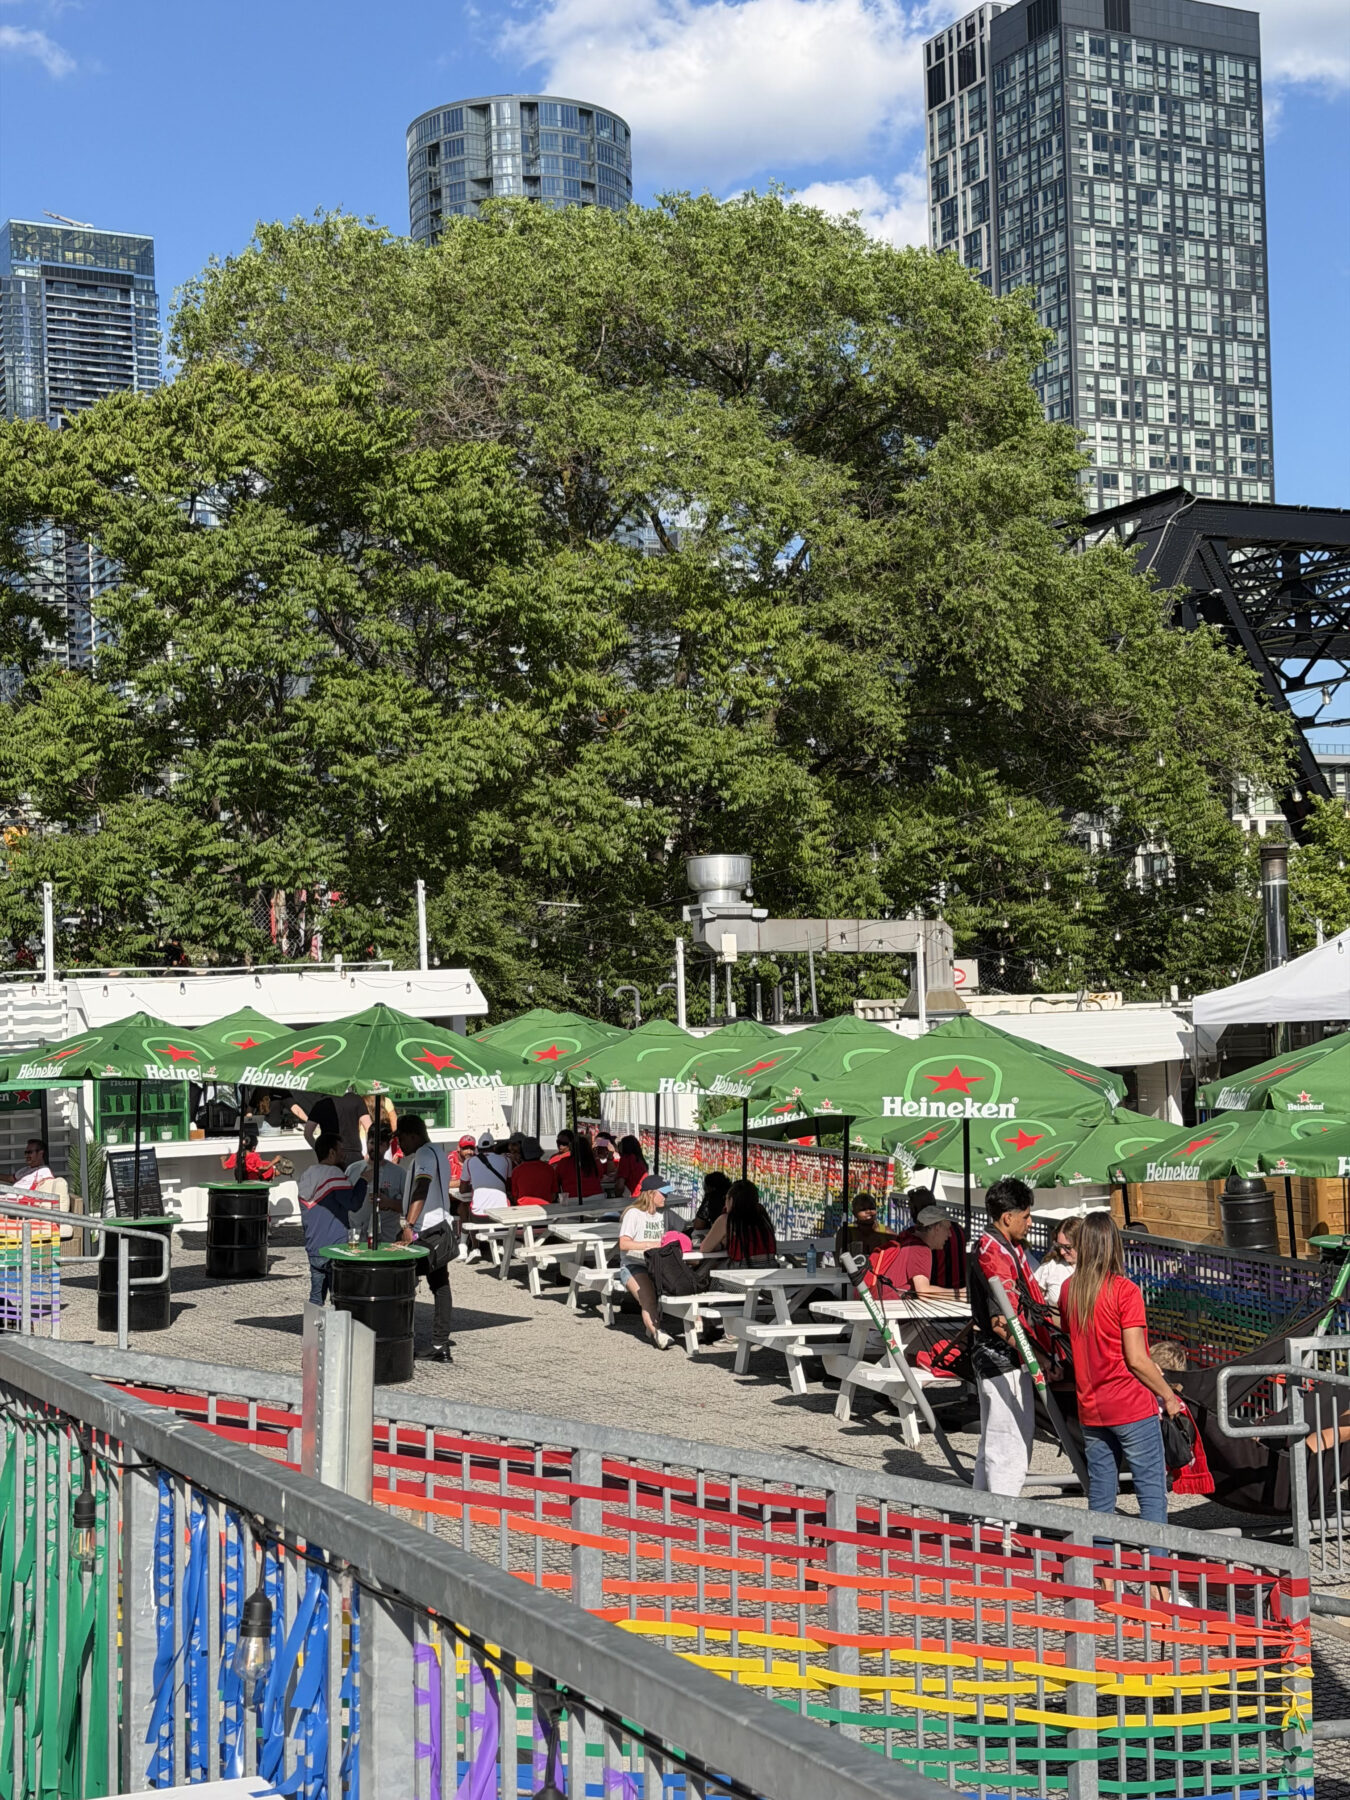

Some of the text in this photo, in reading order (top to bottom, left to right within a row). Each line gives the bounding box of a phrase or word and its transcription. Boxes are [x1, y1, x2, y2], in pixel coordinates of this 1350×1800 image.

[238, 1066, 310, 1090] Heineken
[411, 1072, 505, 1092] Heineken
[882, 1097, 1017, 1118] Heineken
[1144, 1161, 1200, 1181] Heineken
[1011, 1317, 1037, 1364] Heineken
